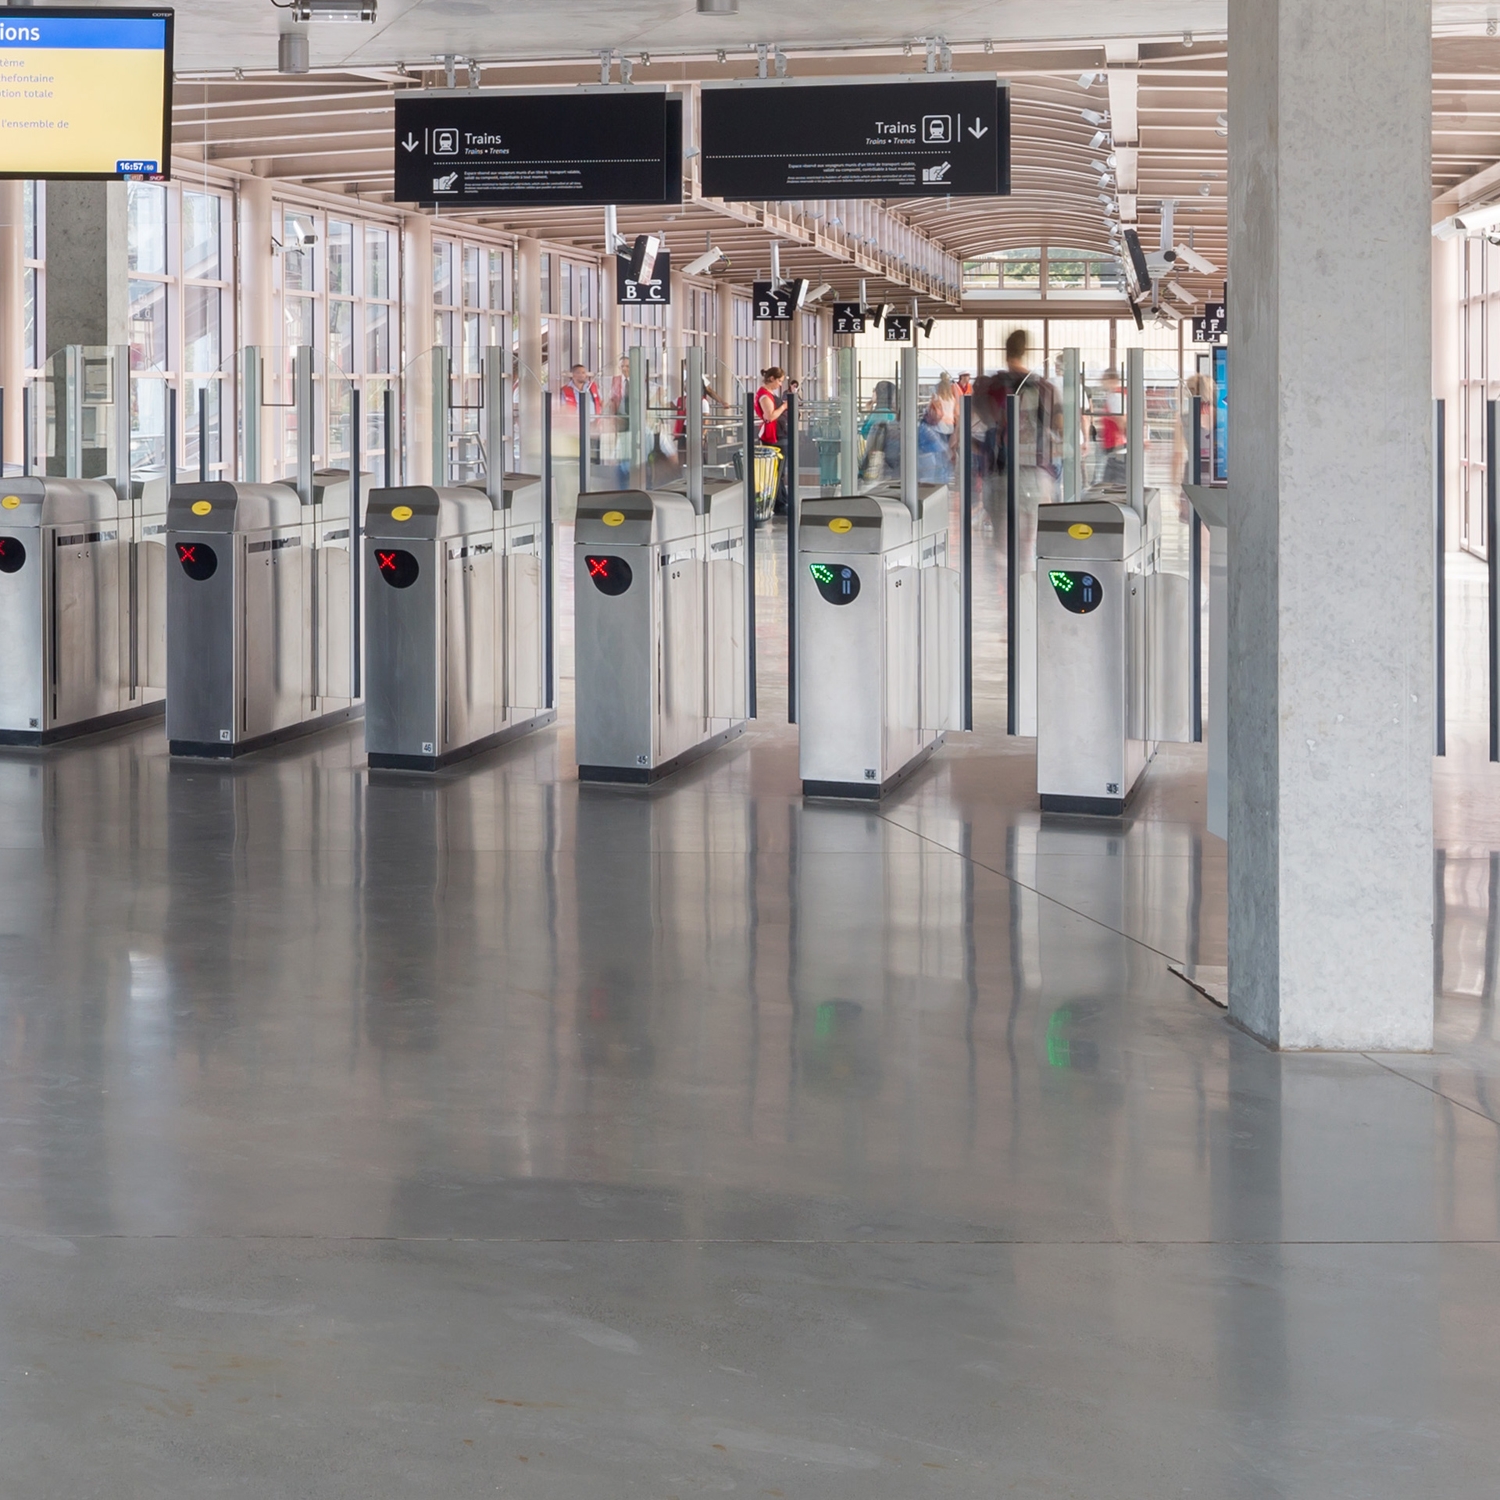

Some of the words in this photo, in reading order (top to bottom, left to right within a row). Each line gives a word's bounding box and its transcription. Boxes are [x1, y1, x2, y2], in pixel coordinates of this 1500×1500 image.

[24, 90, 53, 98] totale
[1, 119, 56, 128] l'ensemble
[57, 120, 69, 128] de
[875, 121, 916, 134] Trains
[464, 133, 502, 145] Trains
[120, 162, 143, 170] 16:57
[626, 285, 637, 299] B
[649, 285, 661, 299] C
[760, 306, 770, 316] D
[778, 306, 786, 316] E
[839, 322, 846, 331] F
[853, 322, 861, 331] G
[1211, 323, 1218, 331] F
[221, 731, 229, 739] 47
[424, 744, 432, 752] 46
[638, 756, 647, 764] 45
[866, 769, 875, 779] 44
[1107, 783, 1118, 793] 43
